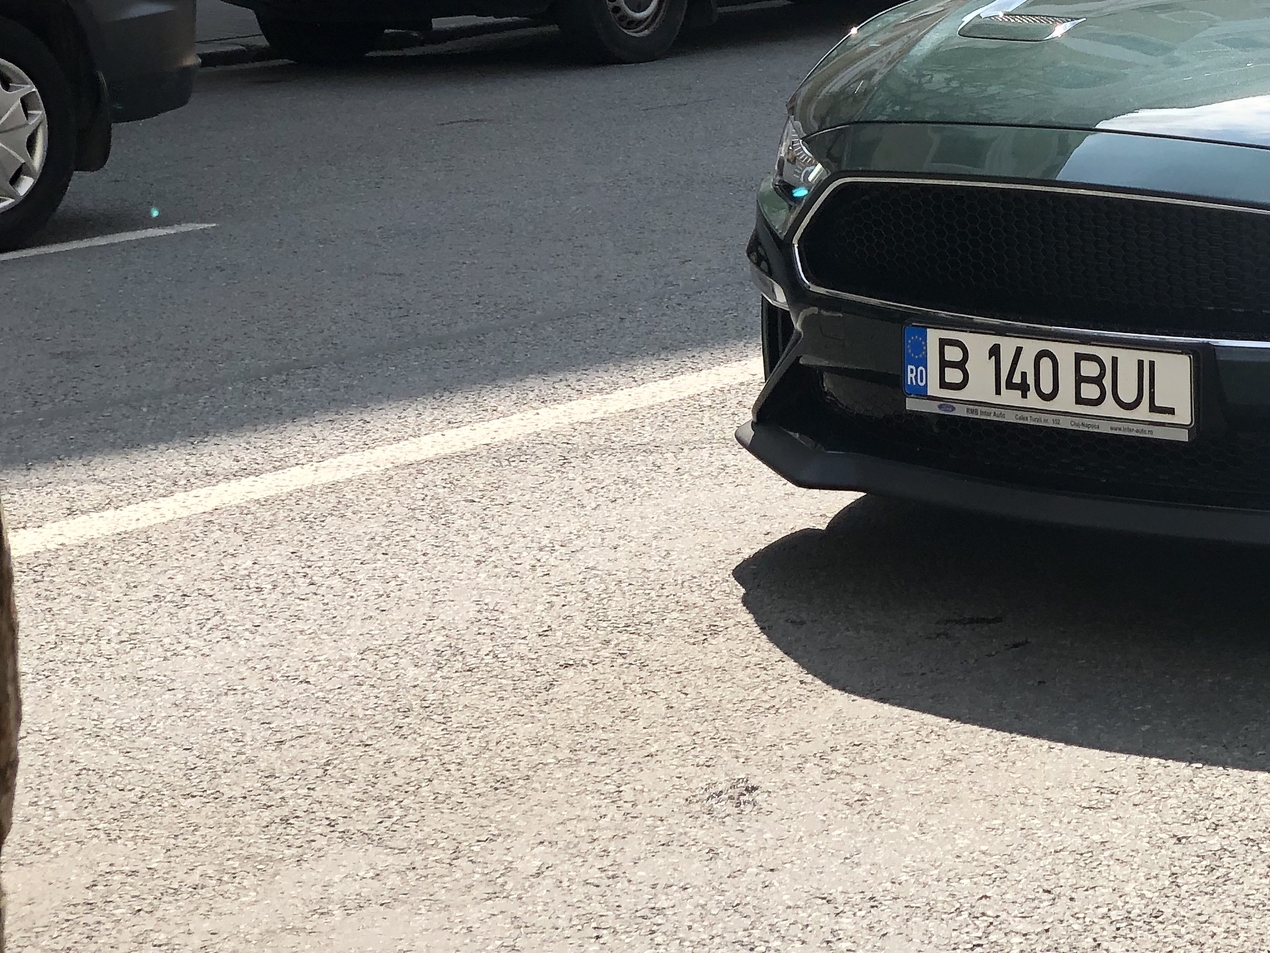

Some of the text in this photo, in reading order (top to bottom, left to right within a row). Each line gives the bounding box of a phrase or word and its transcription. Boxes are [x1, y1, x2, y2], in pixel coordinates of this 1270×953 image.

[907, 365, 926, 387] RO
[938, 338, 1176, 415] B 140 BUL
